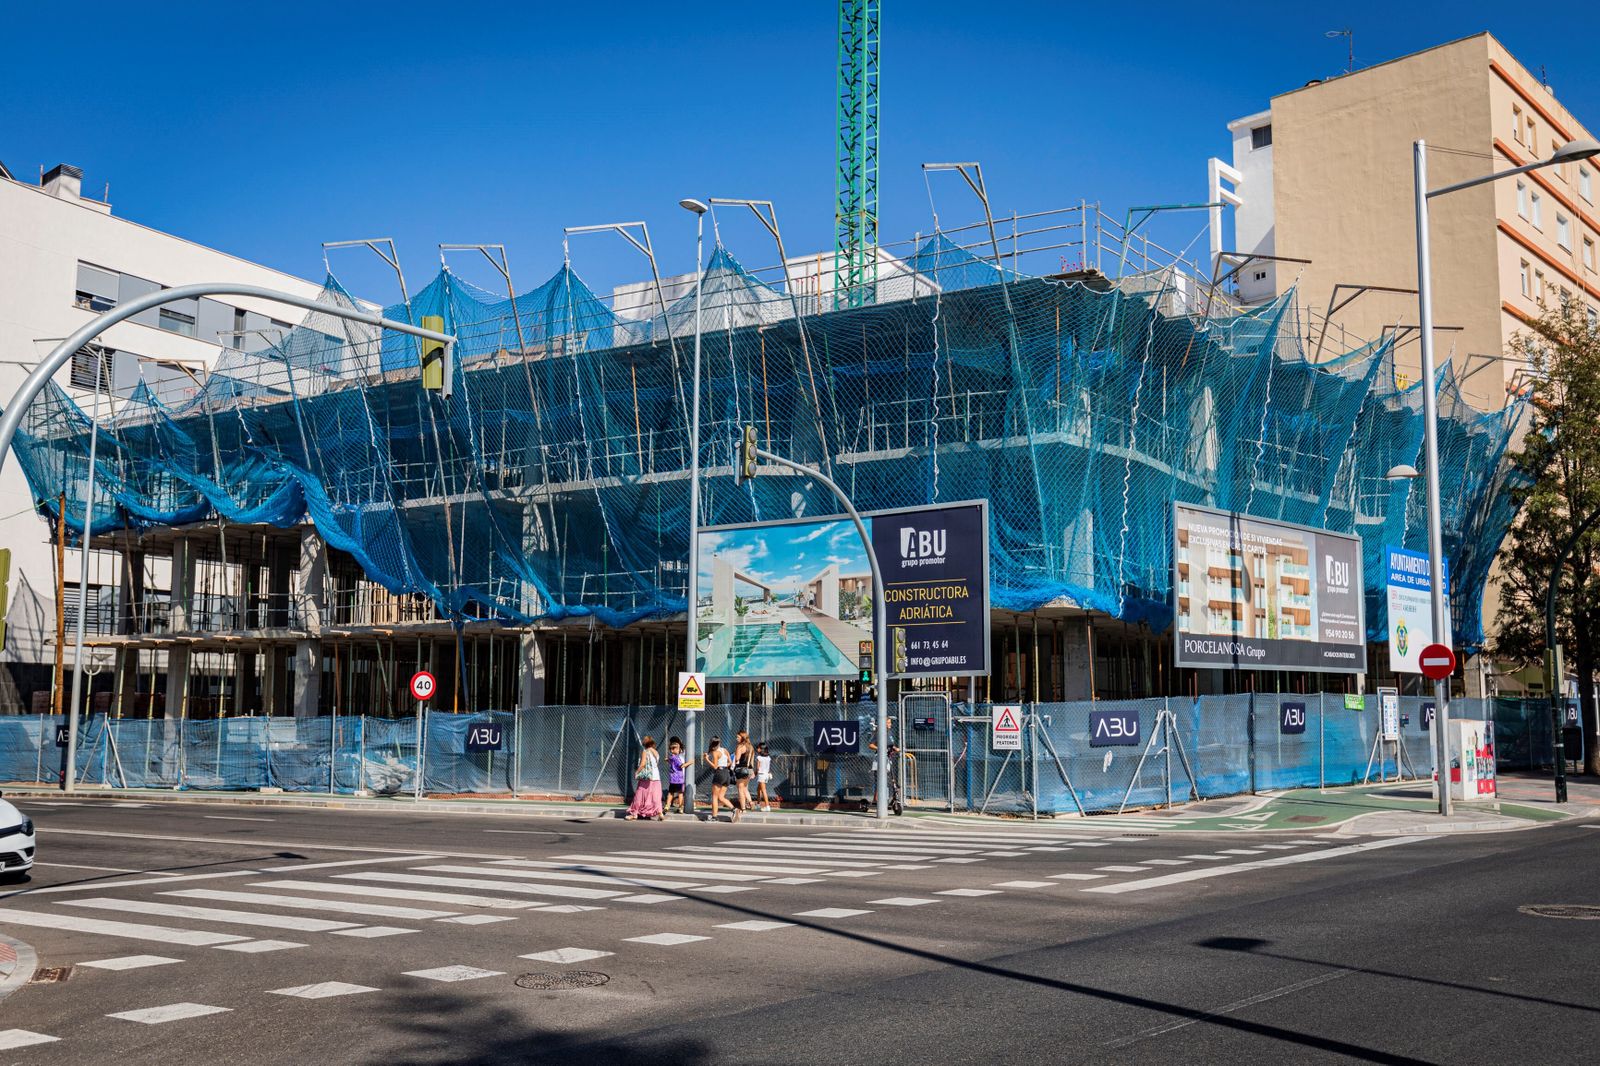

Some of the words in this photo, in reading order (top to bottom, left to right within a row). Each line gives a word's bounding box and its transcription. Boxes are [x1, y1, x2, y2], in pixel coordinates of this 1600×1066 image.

[900, 526, 946, 558] ABU
[1188, 523, 1208, 534] NUEVA
[1256, 535, 1282, 546] VIVIENDAS
[1188, 535, 1222, 548] EXCLUSIVAS
[1230, 540, 1247, 554] CÁDZ
[901, 559, 918, 568] grupo
[919, 556, 946, 566] promotor
[1390, 552, 1425, 576] AYUNTAMIENTO
[1391, 573, 1406, 582] AREA
[1407, 575, 1415, 584] DE
[884, 586, 969, 602] CONSTRUCTORA
[900, 604, 953, 620] ADRIÁTICA
[910, 642, 920, 650] 661
[932, 640, 939, 649] 45
[942, 640, 948, 648] 64
[1184, 640, 1246, 654] PORCELANOSA
[1246, 644, 1265, 660] Grupo
[416, 680, 431, 690] 40
[1284, 708, 1304, 726] ABU
[469, 728, 500, 744] ABU
[816, 728, 856, 746] ABU
[1096, 718, 1136, 738] ABU
